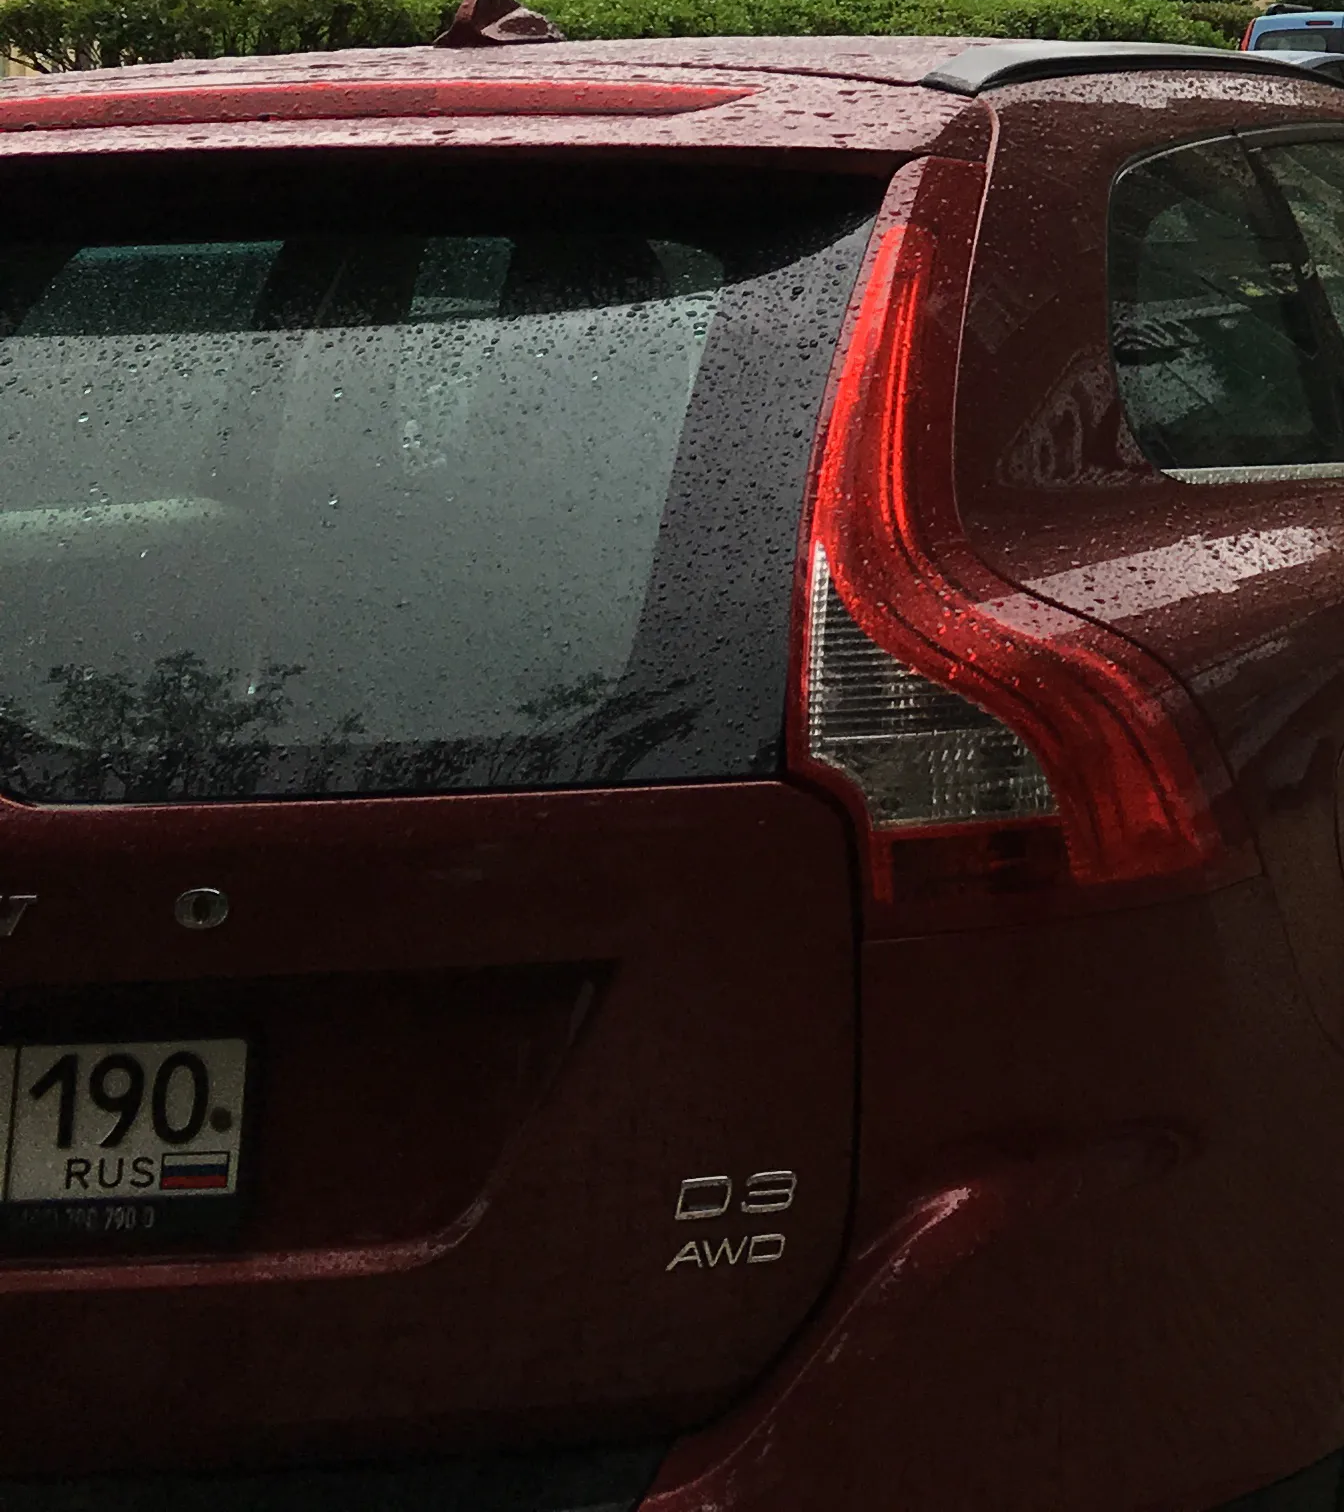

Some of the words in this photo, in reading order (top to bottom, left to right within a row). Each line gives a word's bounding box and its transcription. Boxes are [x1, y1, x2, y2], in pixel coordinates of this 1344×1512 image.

[28, 1050, 210, 1150] 190
[64, 1155, 156, 1190] RUS
[674, 1170, 798, 1221] D3
[665, 1233, 786, 1272] AWD
